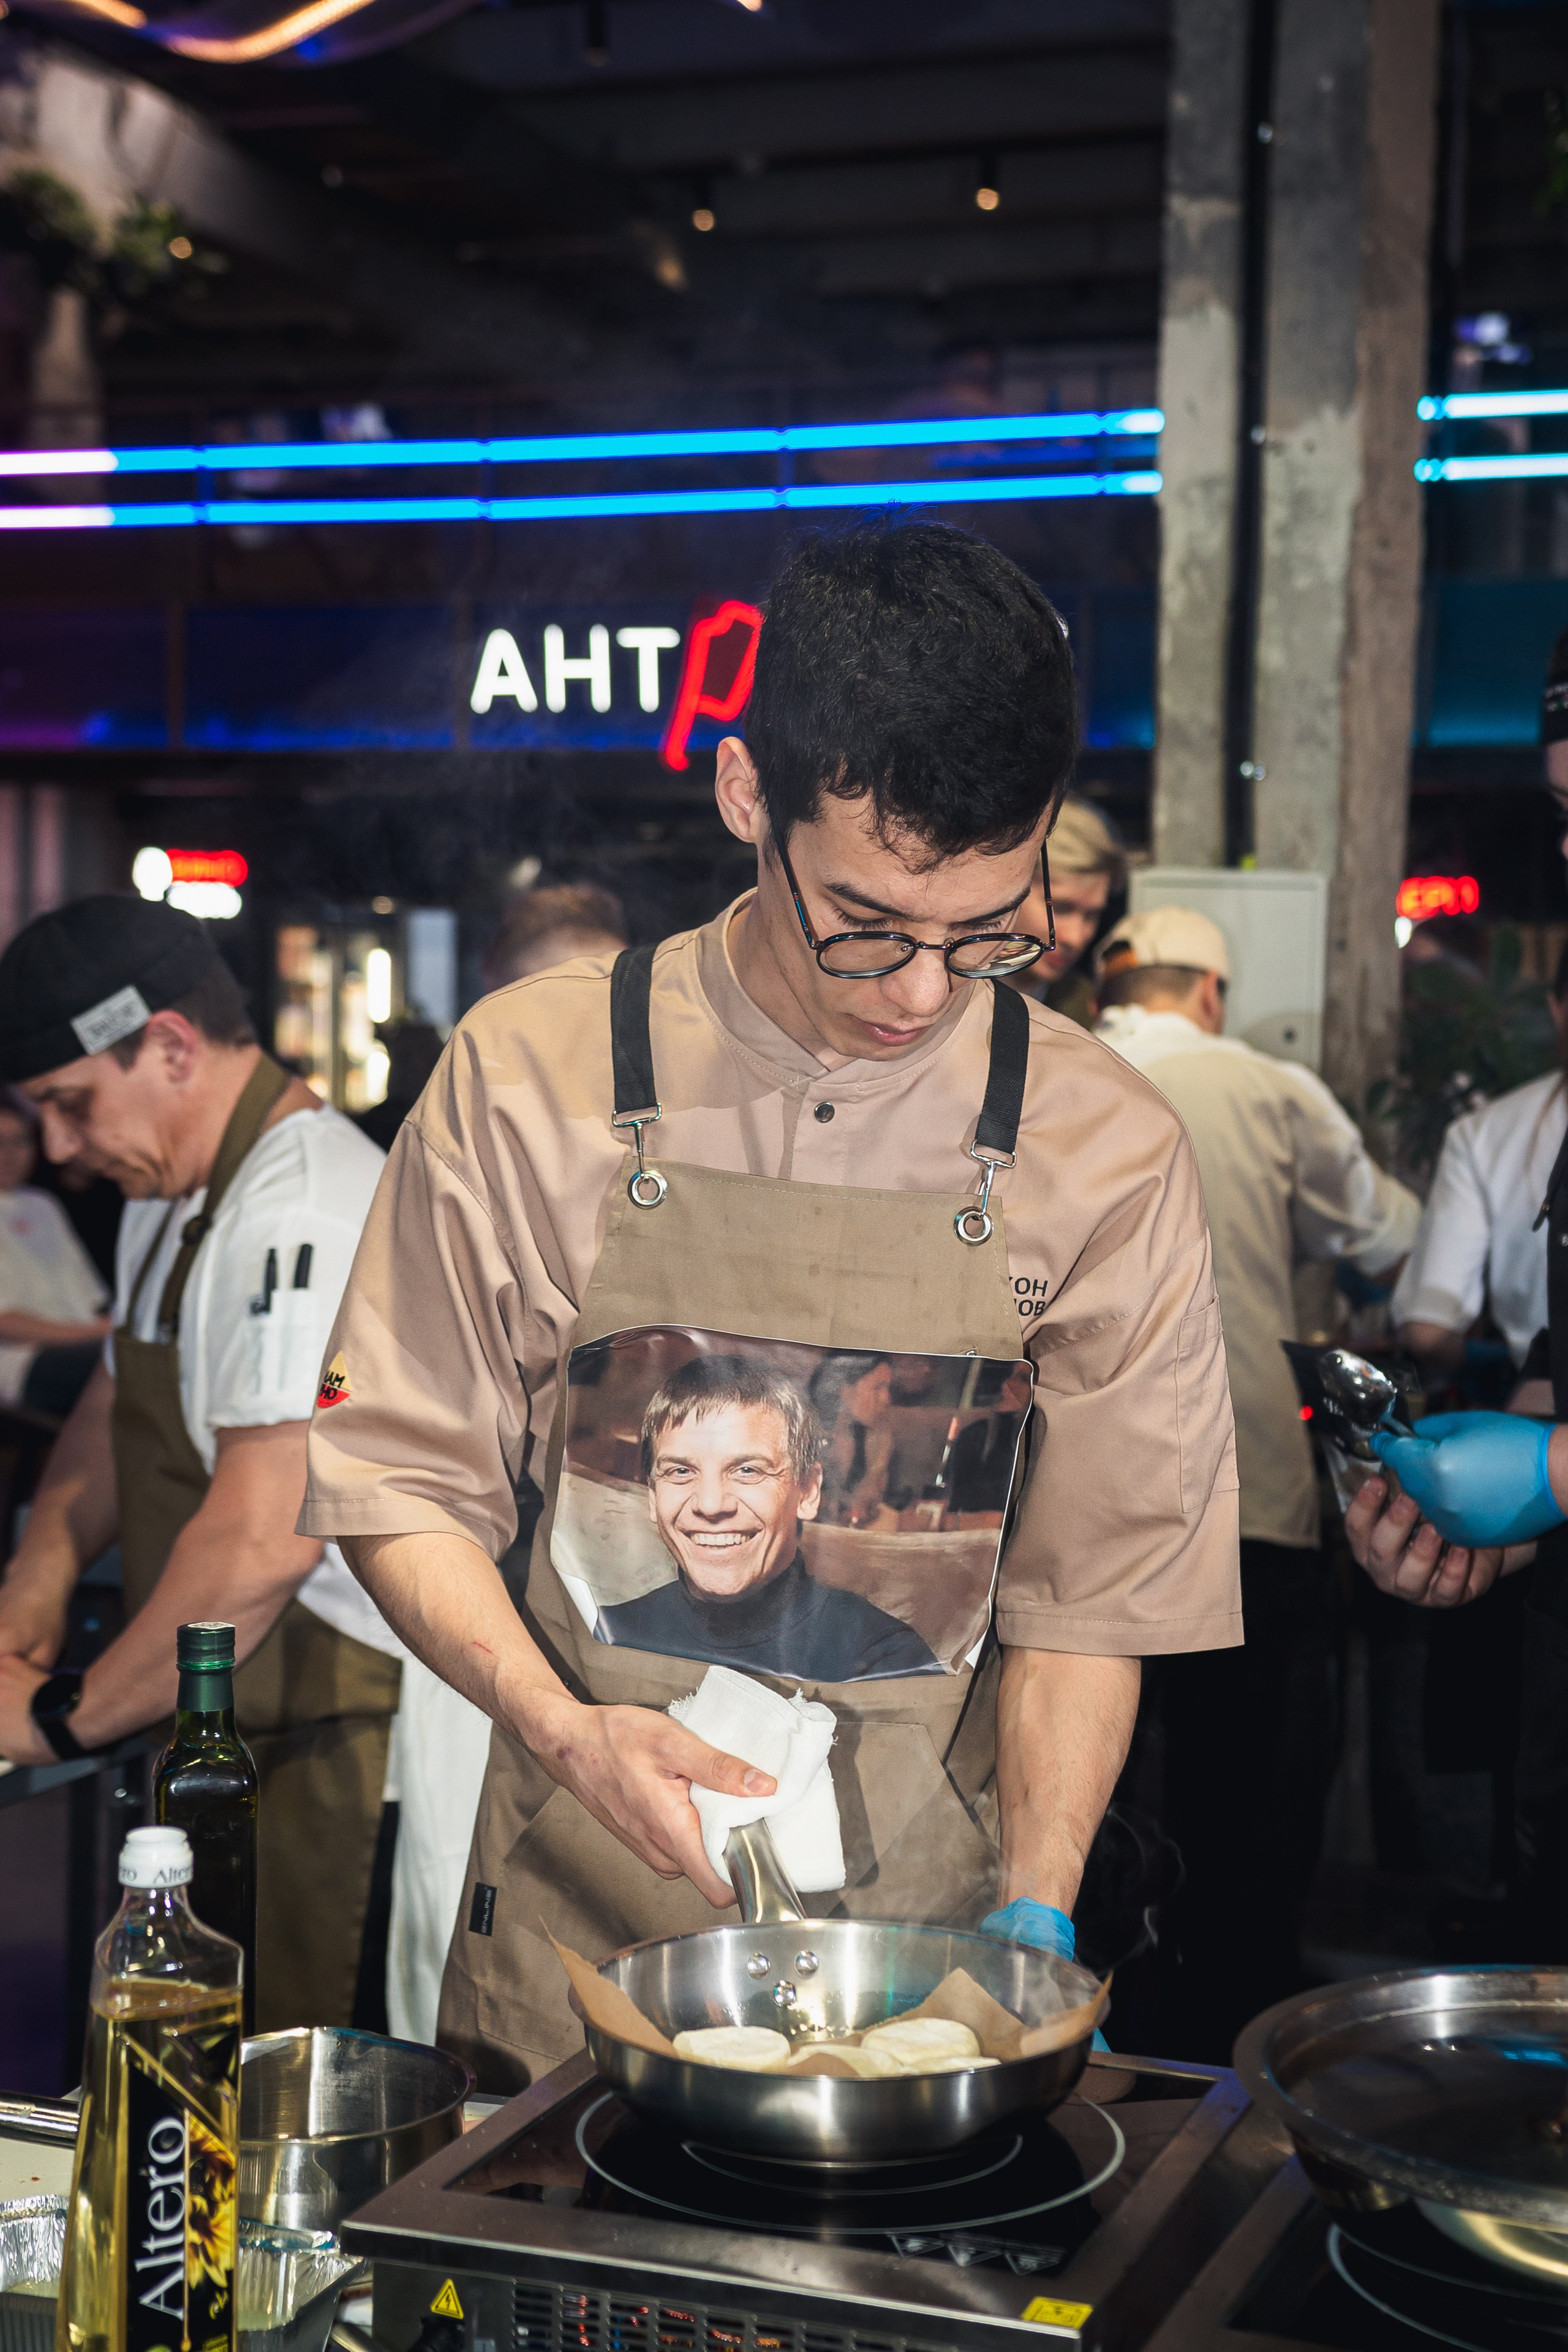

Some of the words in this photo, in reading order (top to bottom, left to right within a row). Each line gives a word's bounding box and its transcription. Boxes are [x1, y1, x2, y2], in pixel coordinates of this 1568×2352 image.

[1009, 1276, 1048, 1297] ОН
[1014, 1298, 1046, 1316] ОВ
[134, 2116, 185, 2321] Altero
